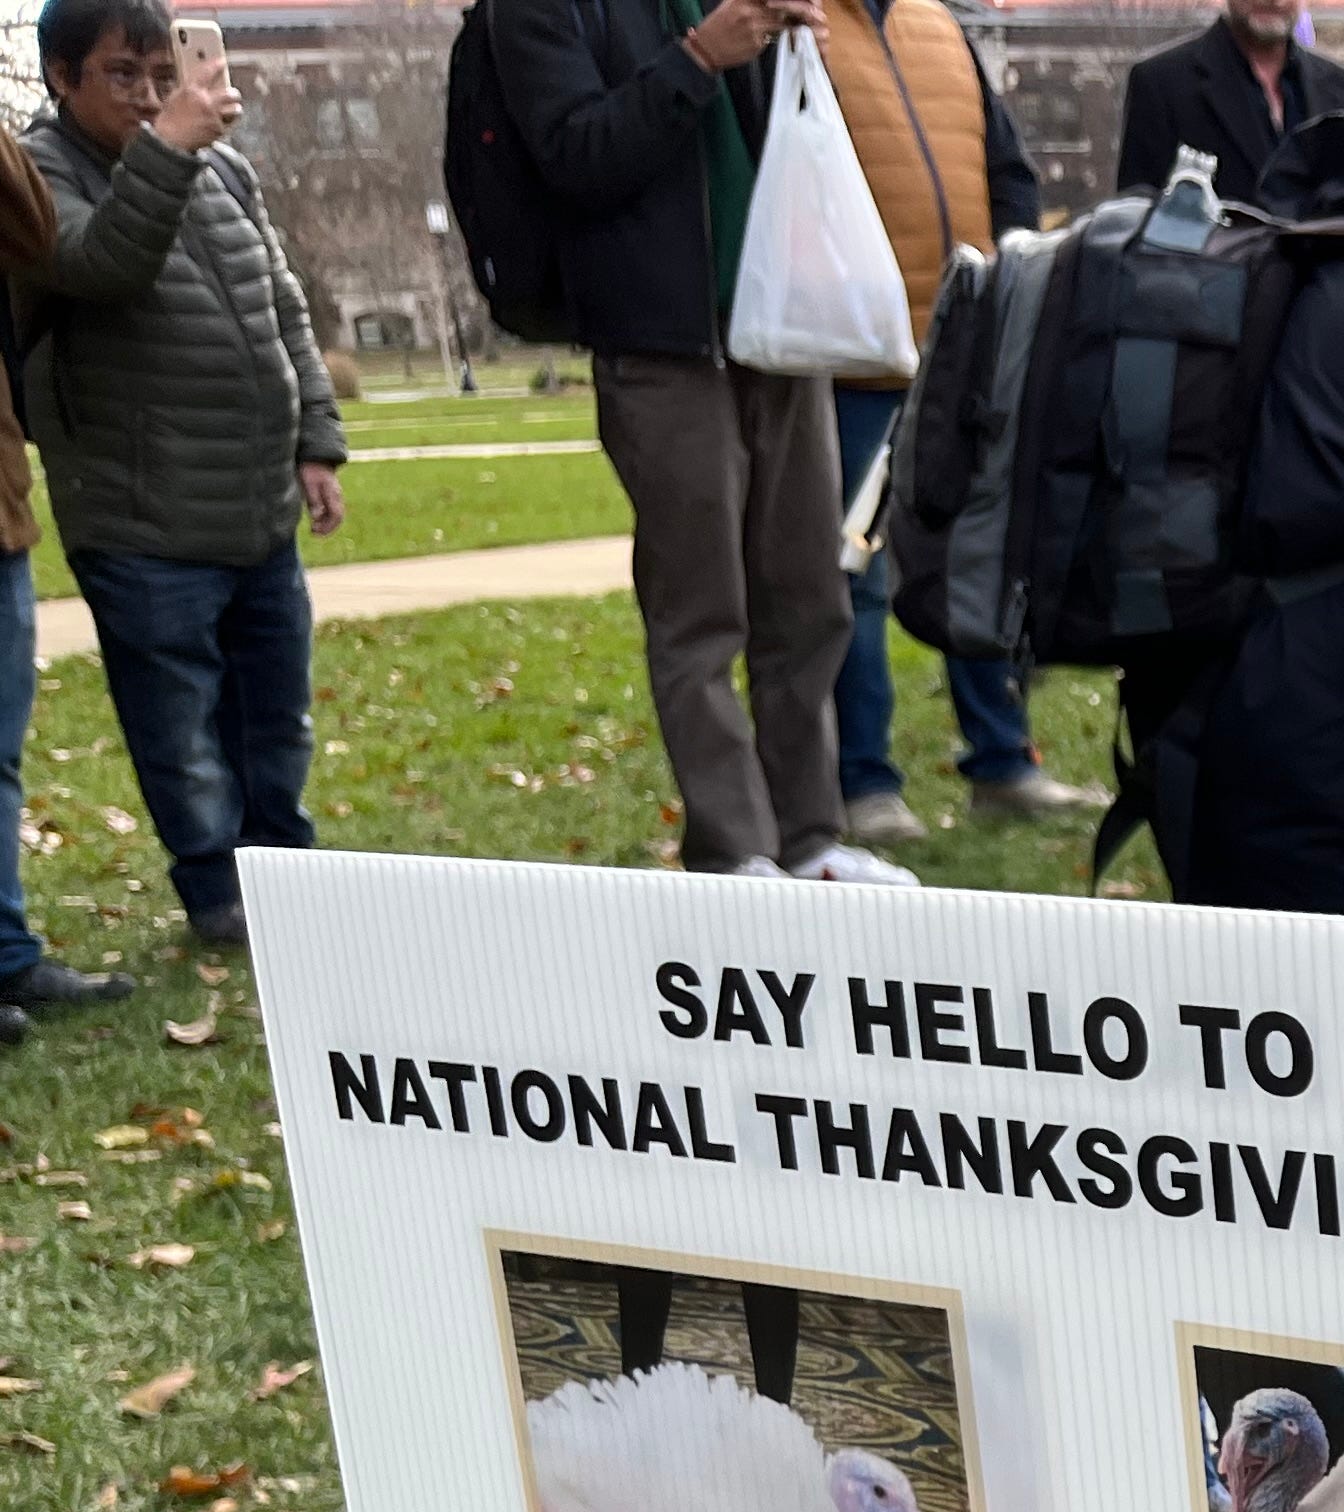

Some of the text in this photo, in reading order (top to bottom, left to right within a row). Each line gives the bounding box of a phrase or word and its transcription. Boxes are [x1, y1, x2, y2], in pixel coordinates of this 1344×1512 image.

[655, 961, 816, 1049] SAY
[847, 977, 1148, 1081] HELLO
[1178, 1004, 1314, 1098] TO
[328, 1050, 736, 1164] NATIONAL
